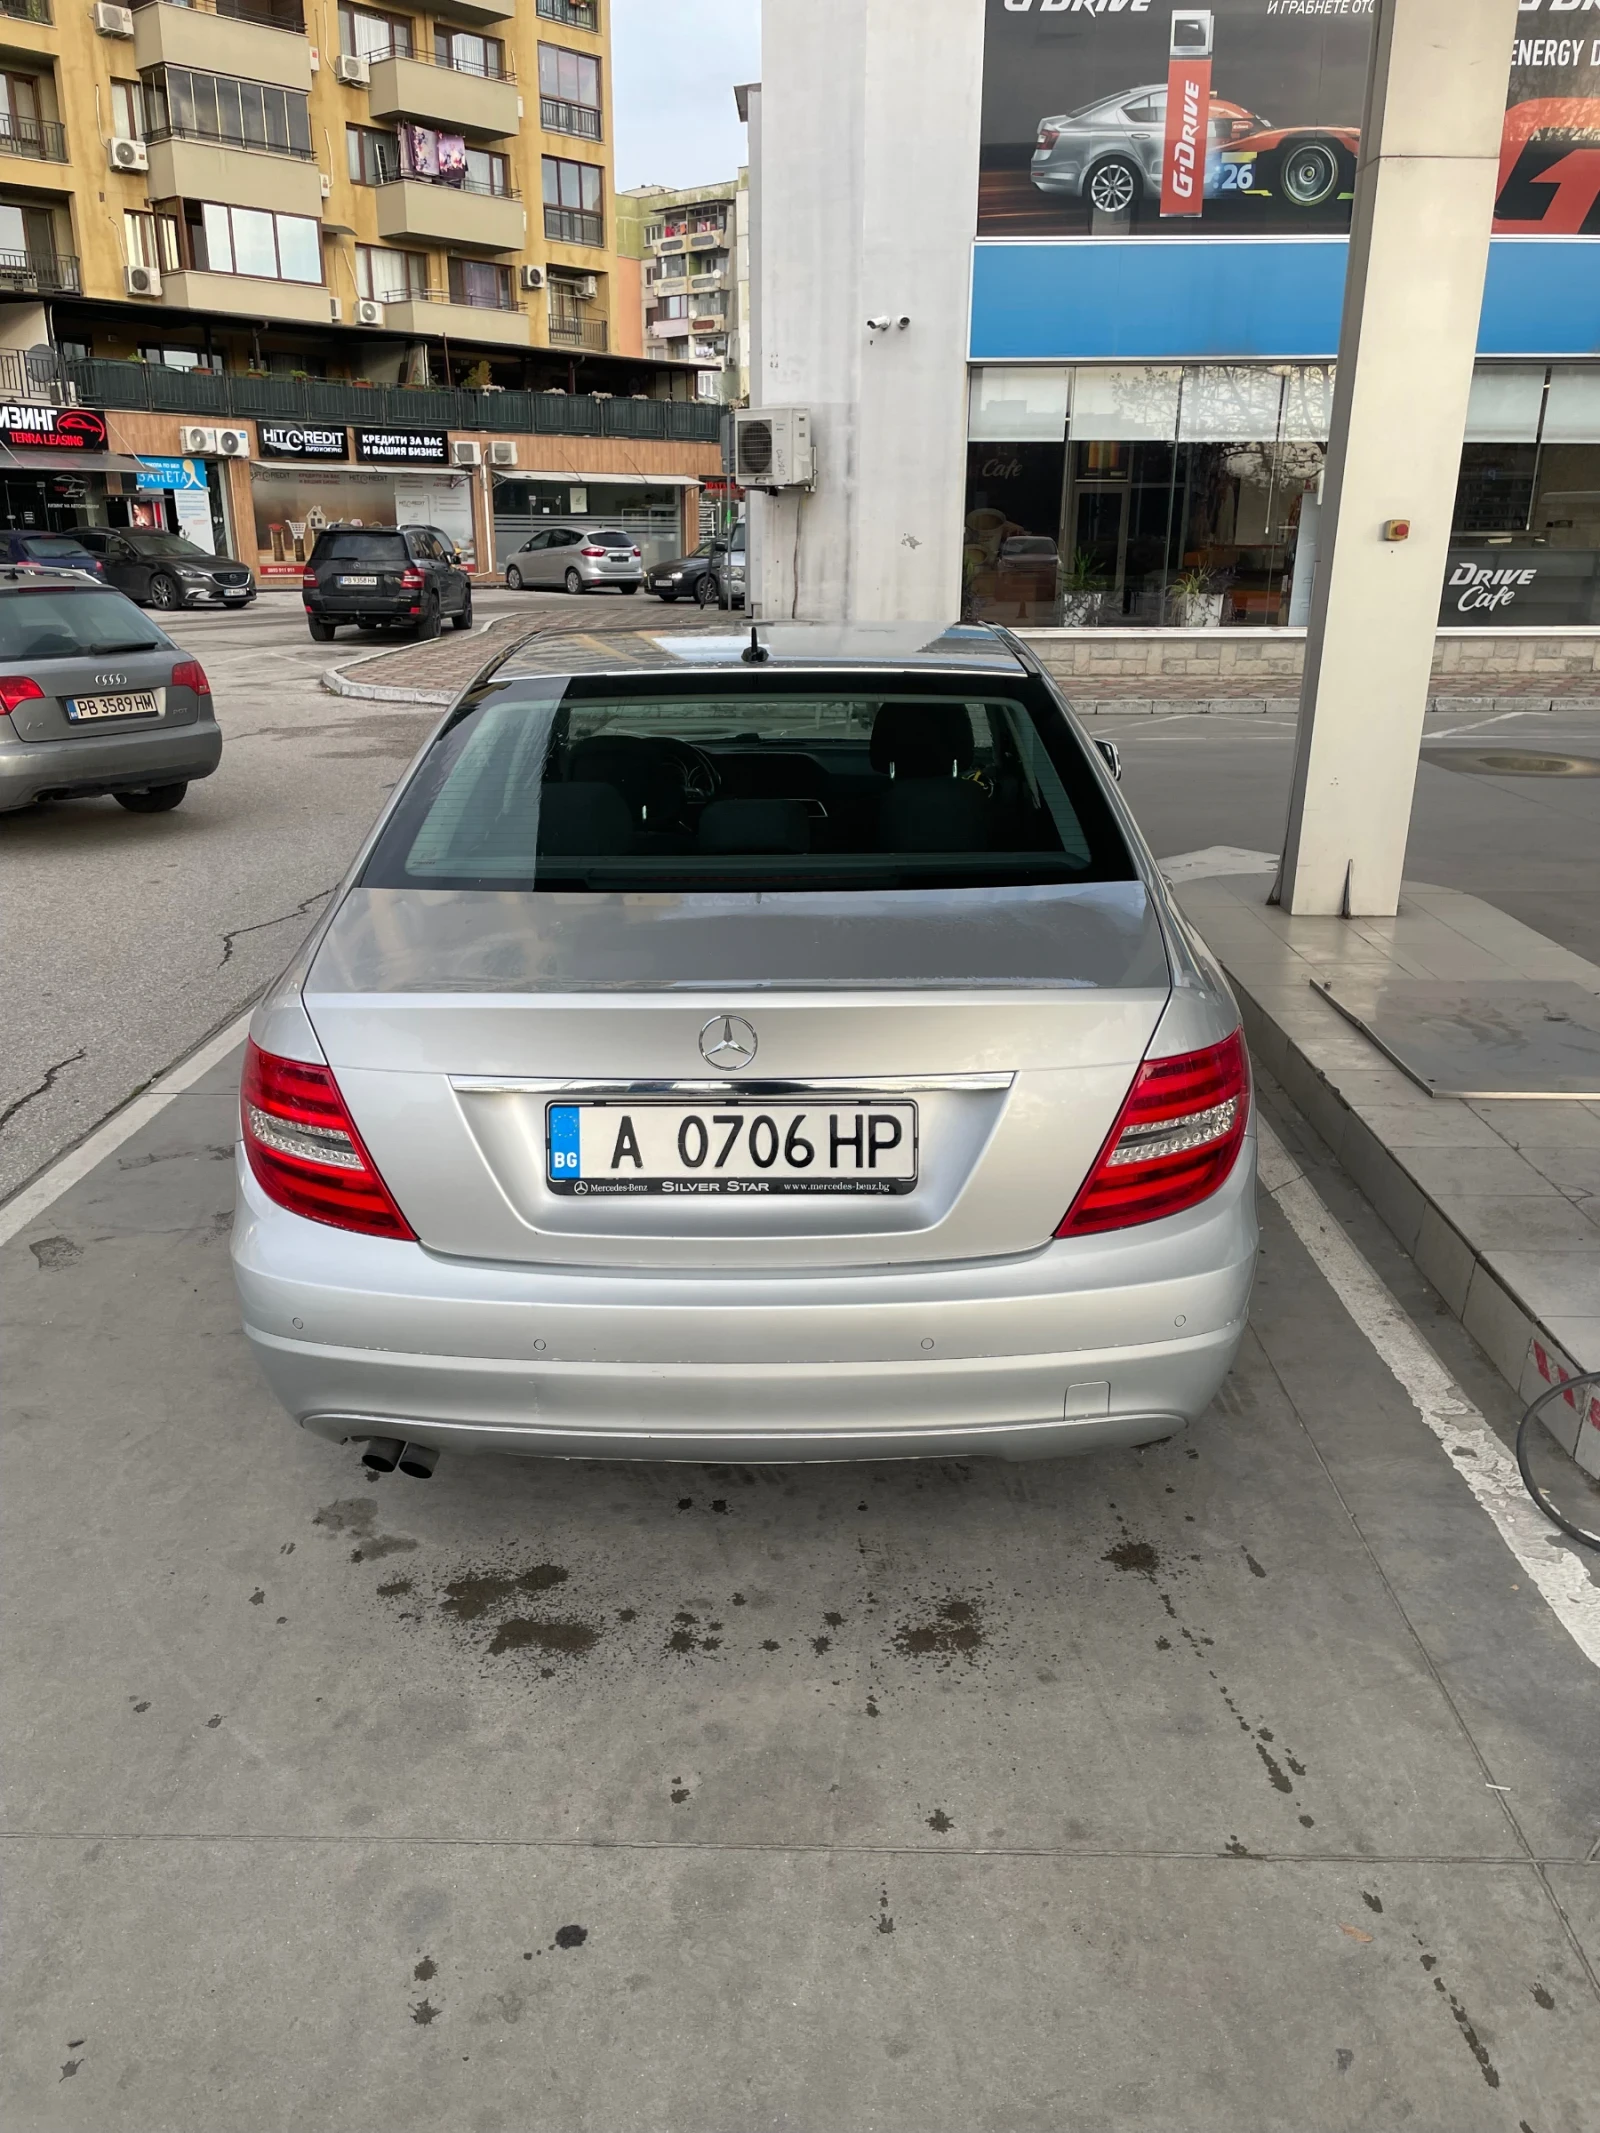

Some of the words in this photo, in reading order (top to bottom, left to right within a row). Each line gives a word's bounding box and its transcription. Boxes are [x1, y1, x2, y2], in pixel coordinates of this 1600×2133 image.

[1267, 0, 1278, 14] И
[1280, 0, 1349, 14] ГРАБНЕТЕ
[1172, 80, 1200, 198] G-DRIVE
[1221, 164, 1253, 190] 26
[9, 432, 42, 444] TERRA
[44, 434, 84, 447] LEASING
[362, 434, 408, 446] КРЕДИТИ
[409, 436, 422, 445] ЗА
[423, 437, 443, 446] ВАС
[363, 445, 370, 454] И
[372, 446, 407, 456] ВАШИЯ
[408, 447, 444, 457] БИЗНЕС
[982, 458, 1023, 479] Cafe
[1448, 562, 1537, 589] DRIVE
[1457, 585, 1515, 612] Cafe
[77, 700, 98, 716] PB
[100, 697, 132, 714] 3589
[135, 695, 154, 711] HM
[611, 1115, 644, 1169] A
[678, 1114, 815, 1168] 0706
[829, 1114, 902, 1168] HP
[554, 1151, 578, 1168] BG
[590, 1184, 648, 1193] Mercedes-Benz
[783, 1182, 890, 1193] www.mercedes-benz.bg
